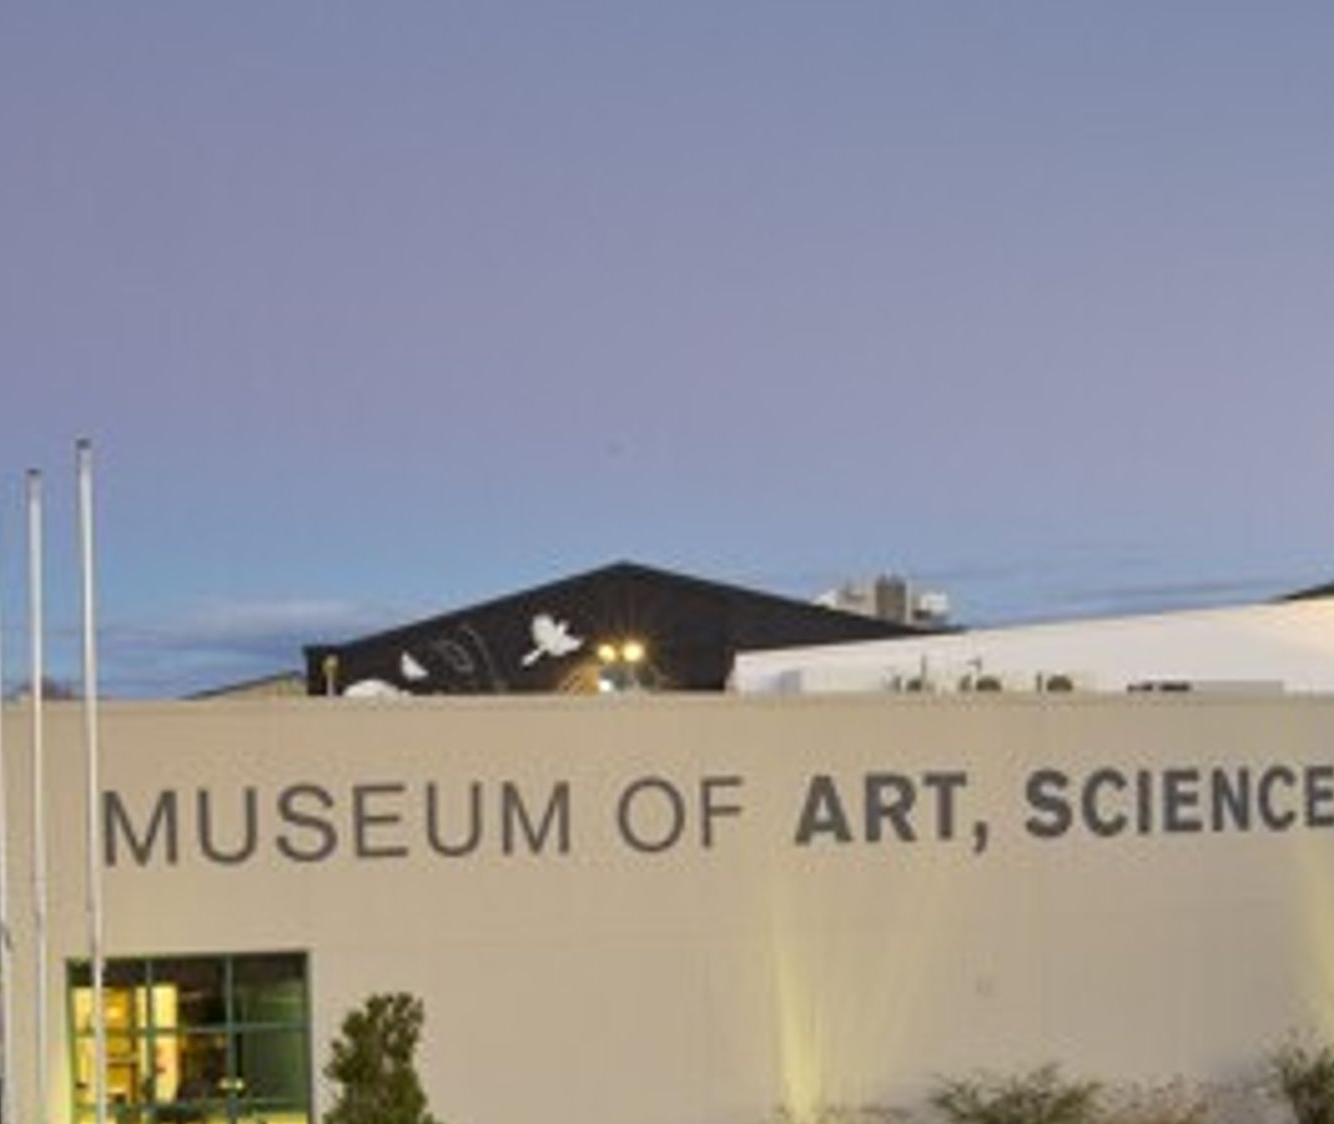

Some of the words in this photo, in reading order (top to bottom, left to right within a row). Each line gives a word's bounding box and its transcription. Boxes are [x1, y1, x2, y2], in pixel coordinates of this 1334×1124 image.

[101, 780, 571, 868] MUSEUM
[616, 775, 743, 854] OF
[794, 772, 990, 854] ART,
